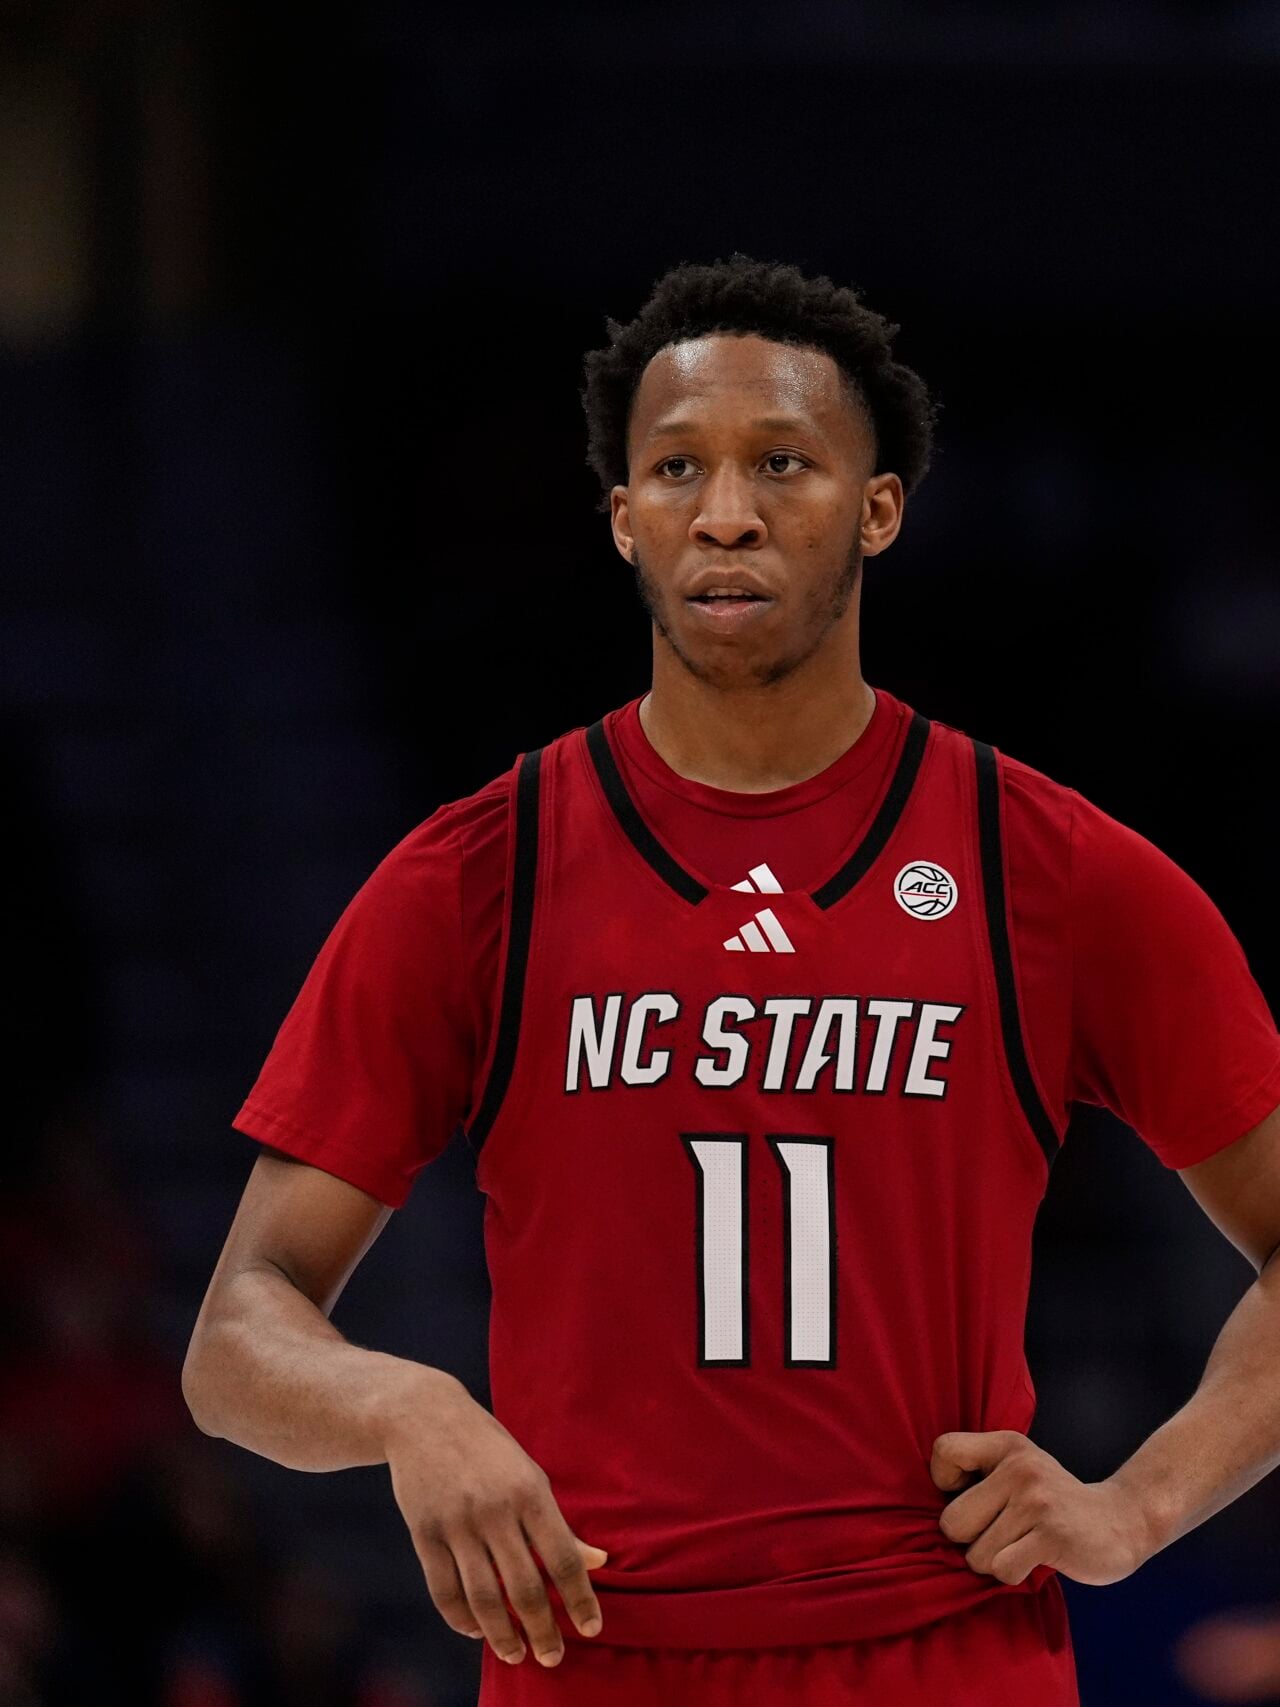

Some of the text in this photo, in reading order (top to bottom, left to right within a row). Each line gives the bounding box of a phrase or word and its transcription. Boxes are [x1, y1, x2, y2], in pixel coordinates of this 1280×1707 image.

[904, 881, 951, 895] ACC
[563, 991, 965, 1099] NC STATE
[679, 1132, 838, 1370] 11
